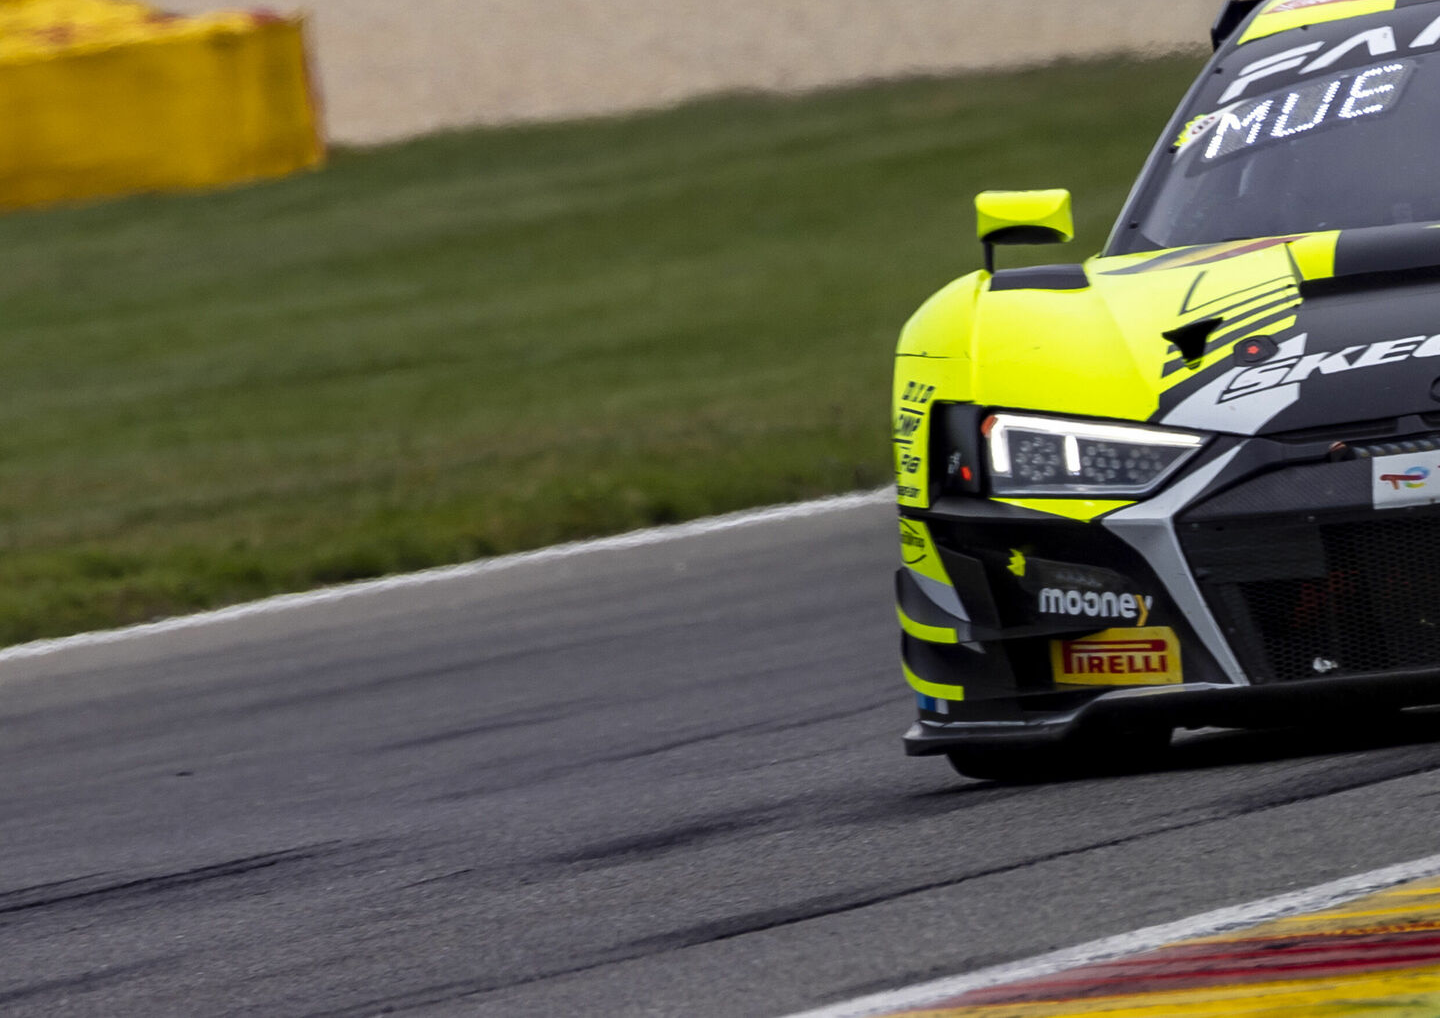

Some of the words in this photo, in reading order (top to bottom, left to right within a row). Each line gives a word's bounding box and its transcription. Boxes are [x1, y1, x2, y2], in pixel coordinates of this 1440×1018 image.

[1205, 64, 1403, 159] MUE
[1040, 588, 1152, 627] mooney
[1062, 638, 1168, 674] PIRELLI
